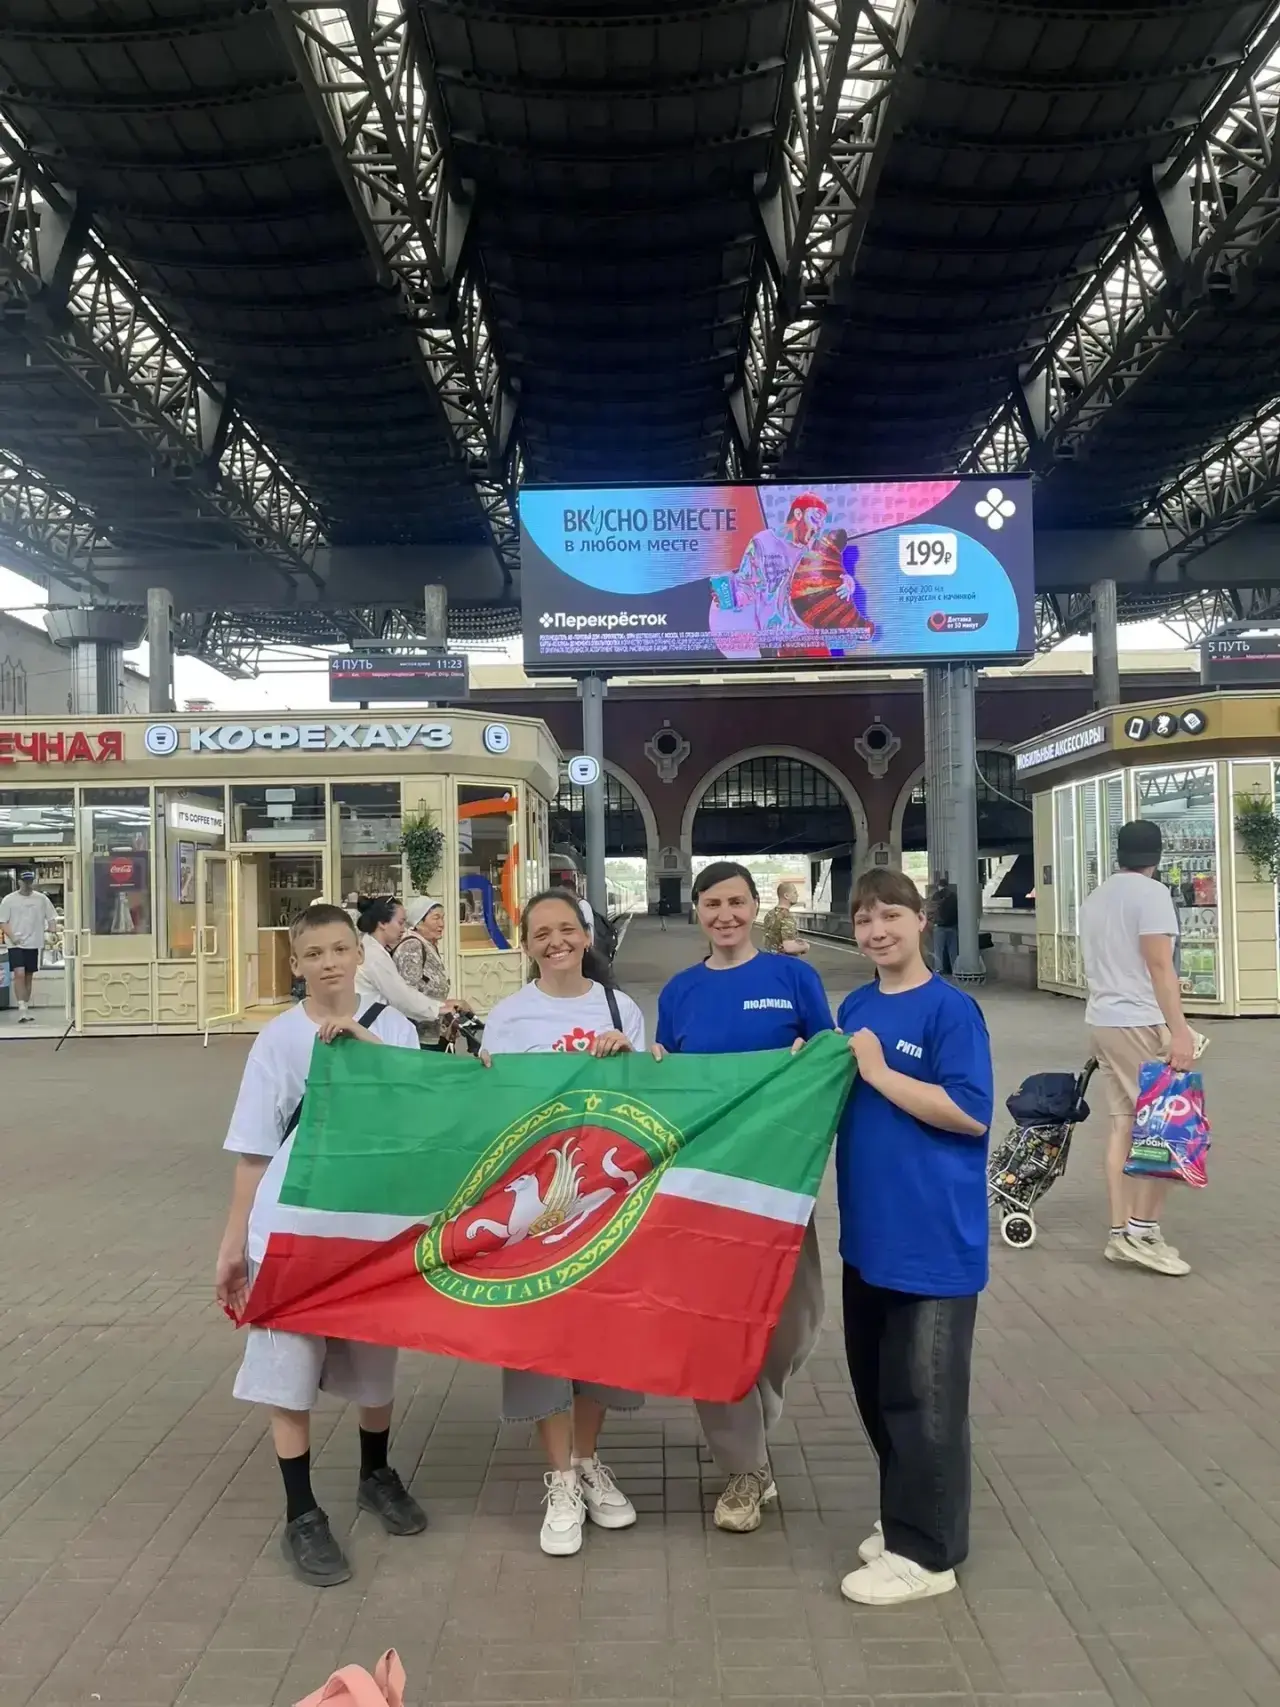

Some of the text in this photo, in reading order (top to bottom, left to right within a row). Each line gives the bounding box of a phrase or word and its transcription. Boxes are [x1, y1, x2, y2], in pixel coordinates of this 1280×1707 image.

[563, 505, 737, 536] ВКУСНО ВМЕСТЕ
[565, 536, 699, 552] в любом месте
[554, 611, 668, 630] Перекрёсток
[1208, 641, 1250, 652] 5 ПУТЬ
[331, 659, 373, 670] 4 ПУТЬ
[437, 659, 463, 669] 11:23
[189, 723, 453, 751] КОФЕХАУЗ
[1016, 726, 1105, 770] МОБИЛЬНЫЕ АКСЕССУАРЫ
[190, 813, 210, 825] COFFEE
[743, 997, 793, 1010] ЛЮДМИЛА
[896, 1039, 923, 1059] РИТА
